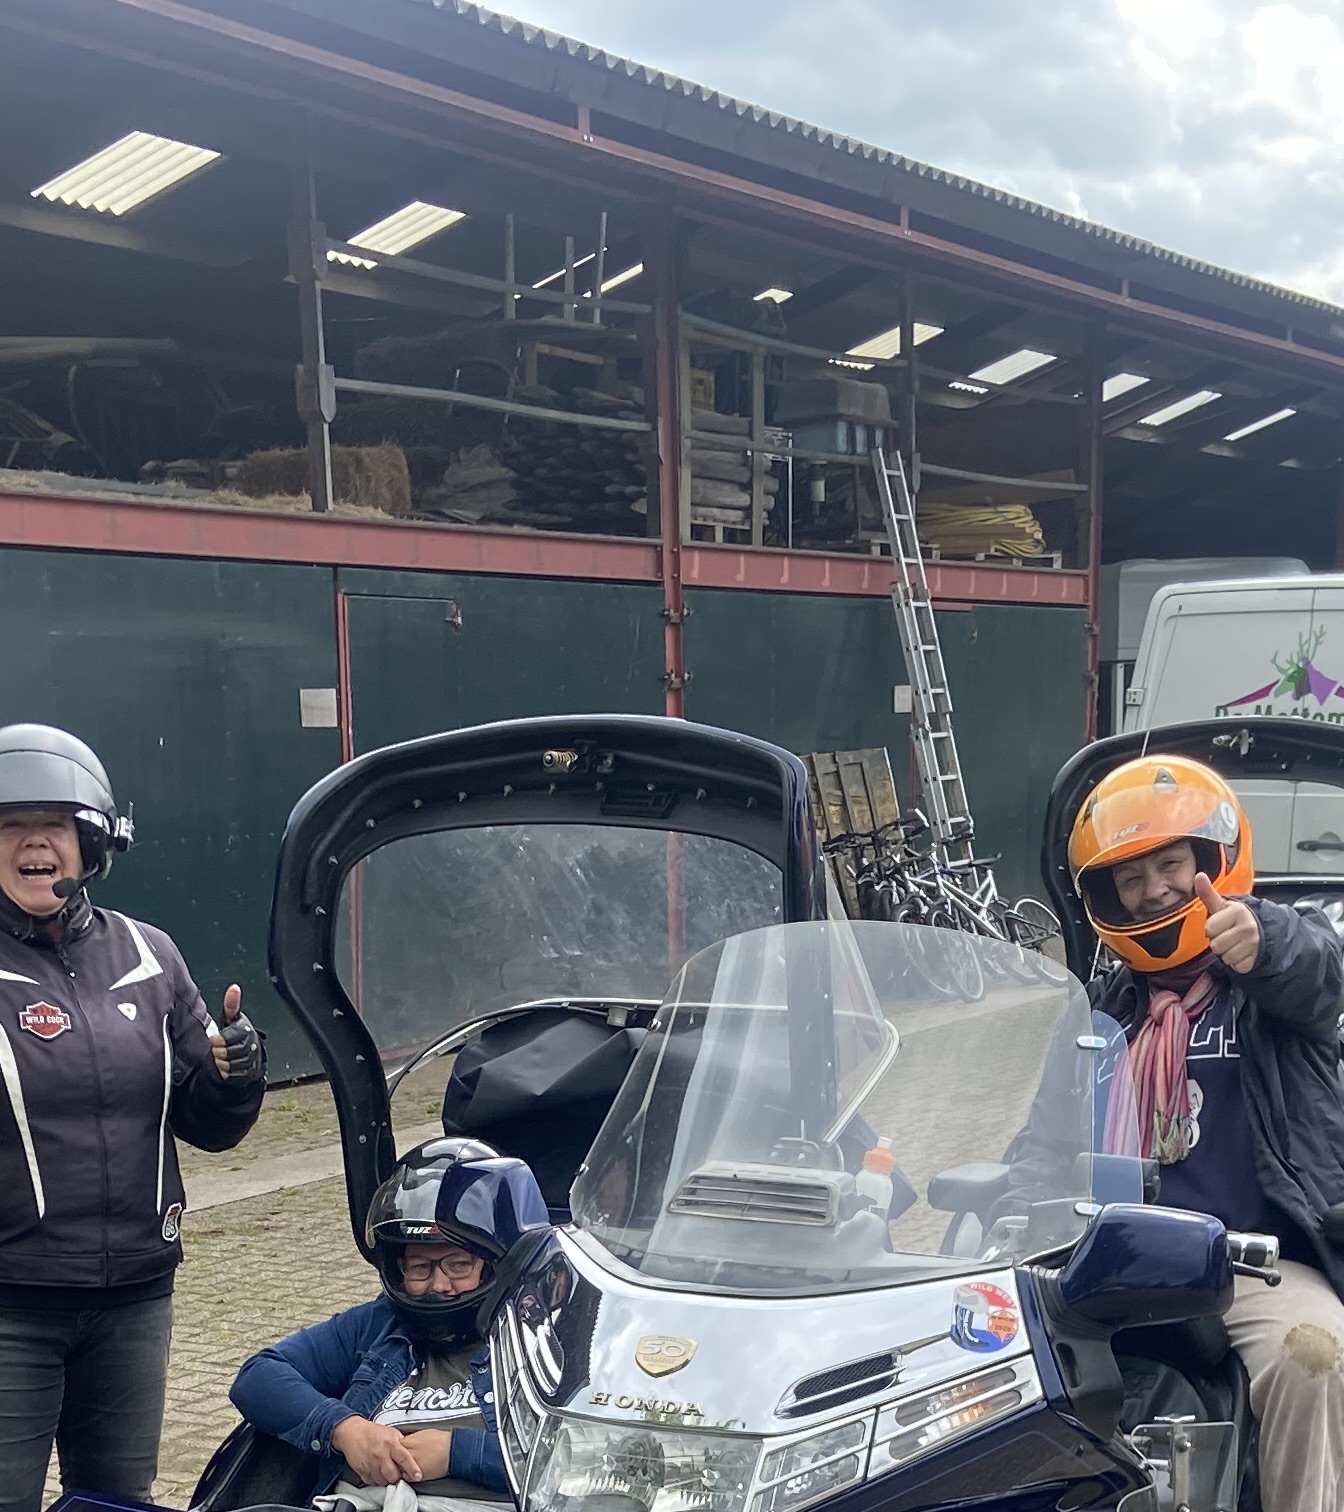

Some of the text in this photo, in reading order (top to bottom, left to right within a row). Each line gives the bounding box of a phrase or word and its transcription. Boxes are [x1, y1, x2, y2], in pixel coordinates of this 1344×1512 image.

[970, 1283, 994, 1292] WILD
[638, 1341, 687, 1358] 50
[589, 1391, 705, 1418] HONDA
